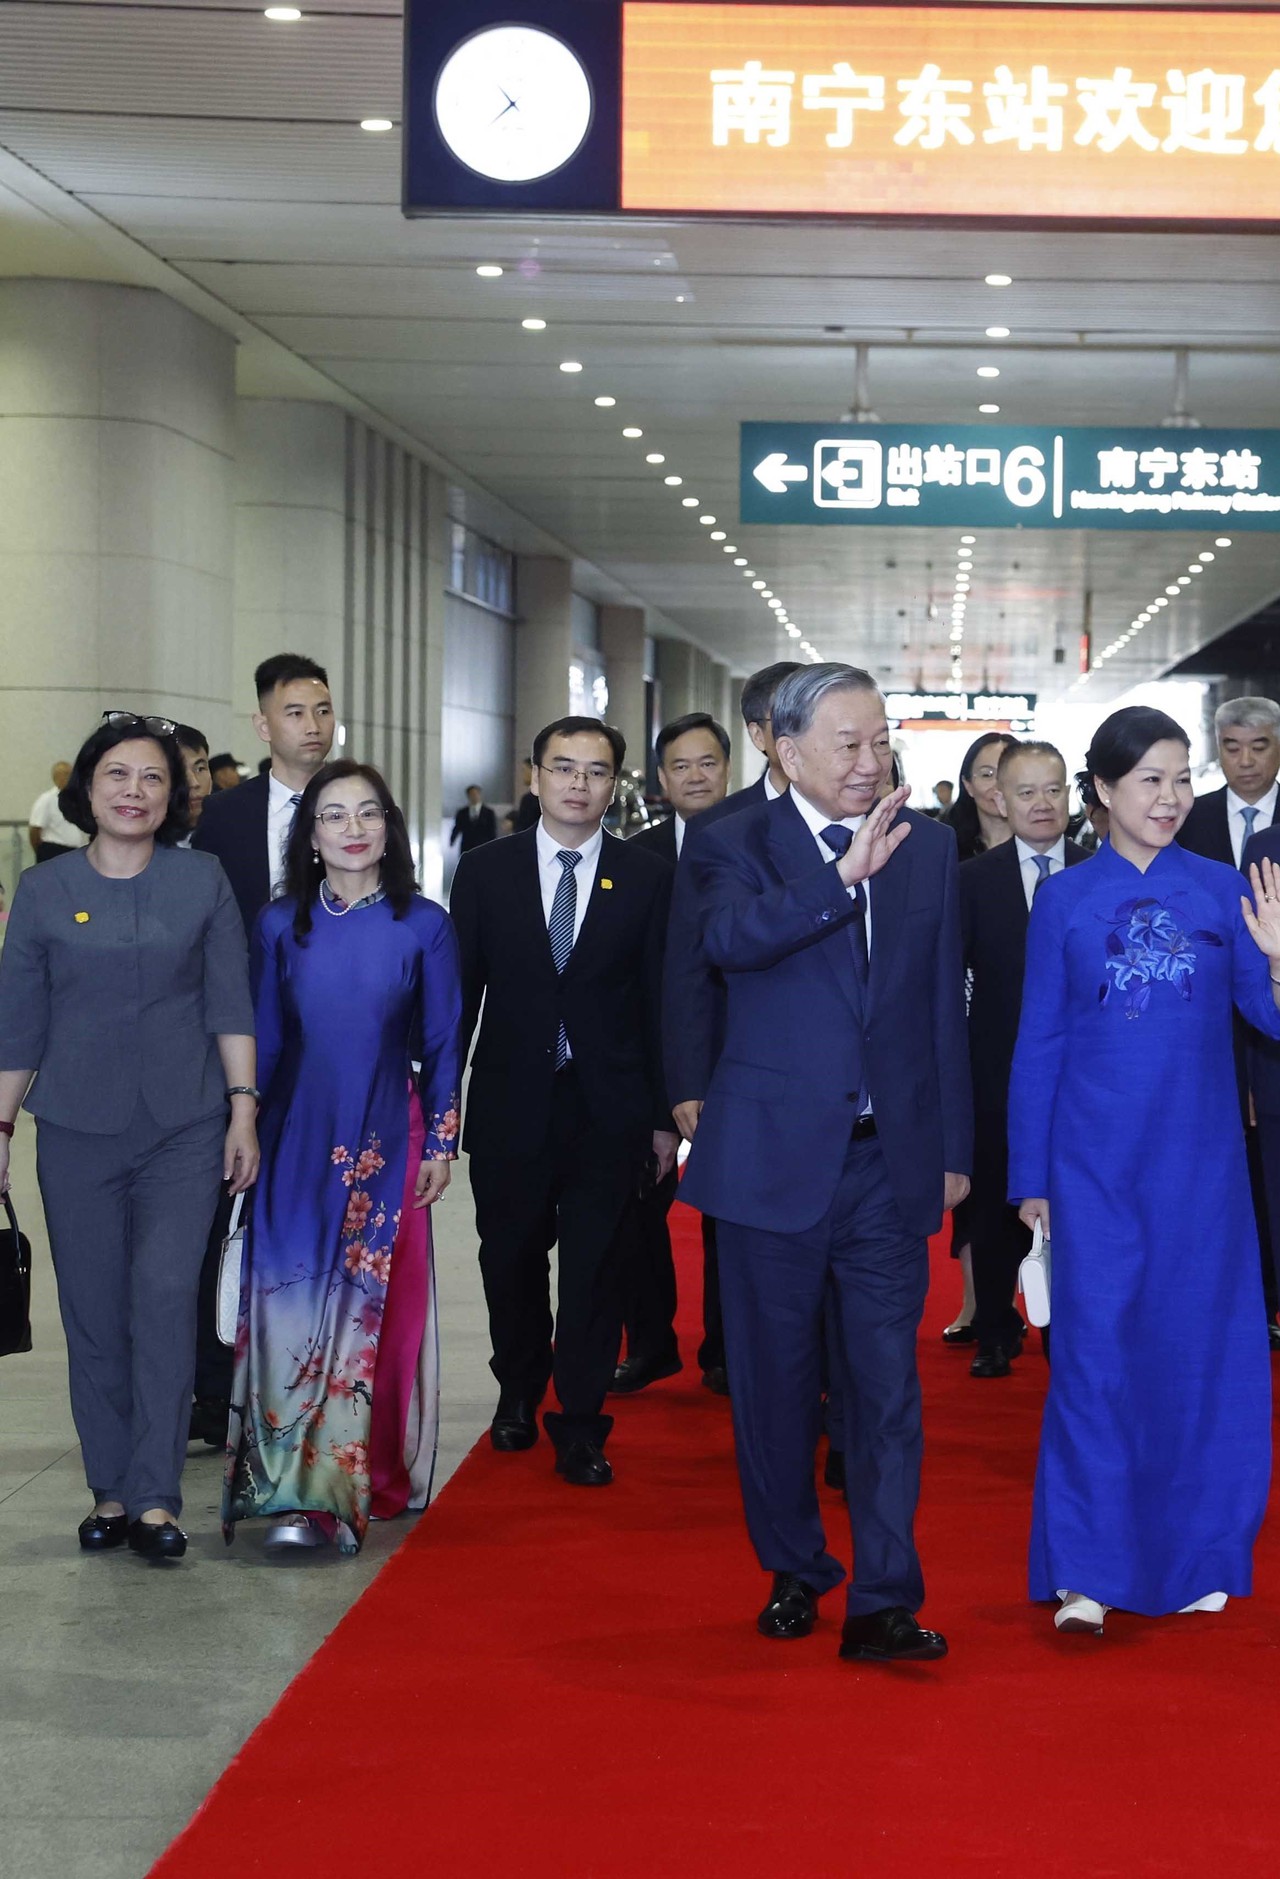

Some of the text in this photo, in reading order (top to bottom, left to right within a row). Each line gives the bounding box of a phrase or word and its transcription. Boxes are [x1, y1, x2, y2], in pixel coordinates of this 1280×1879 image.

[887, 444, 1001, 486] 出站口
[1003, 445, 1046, 507] 6
[1097, 446, 1262, 490] 南宁东站
